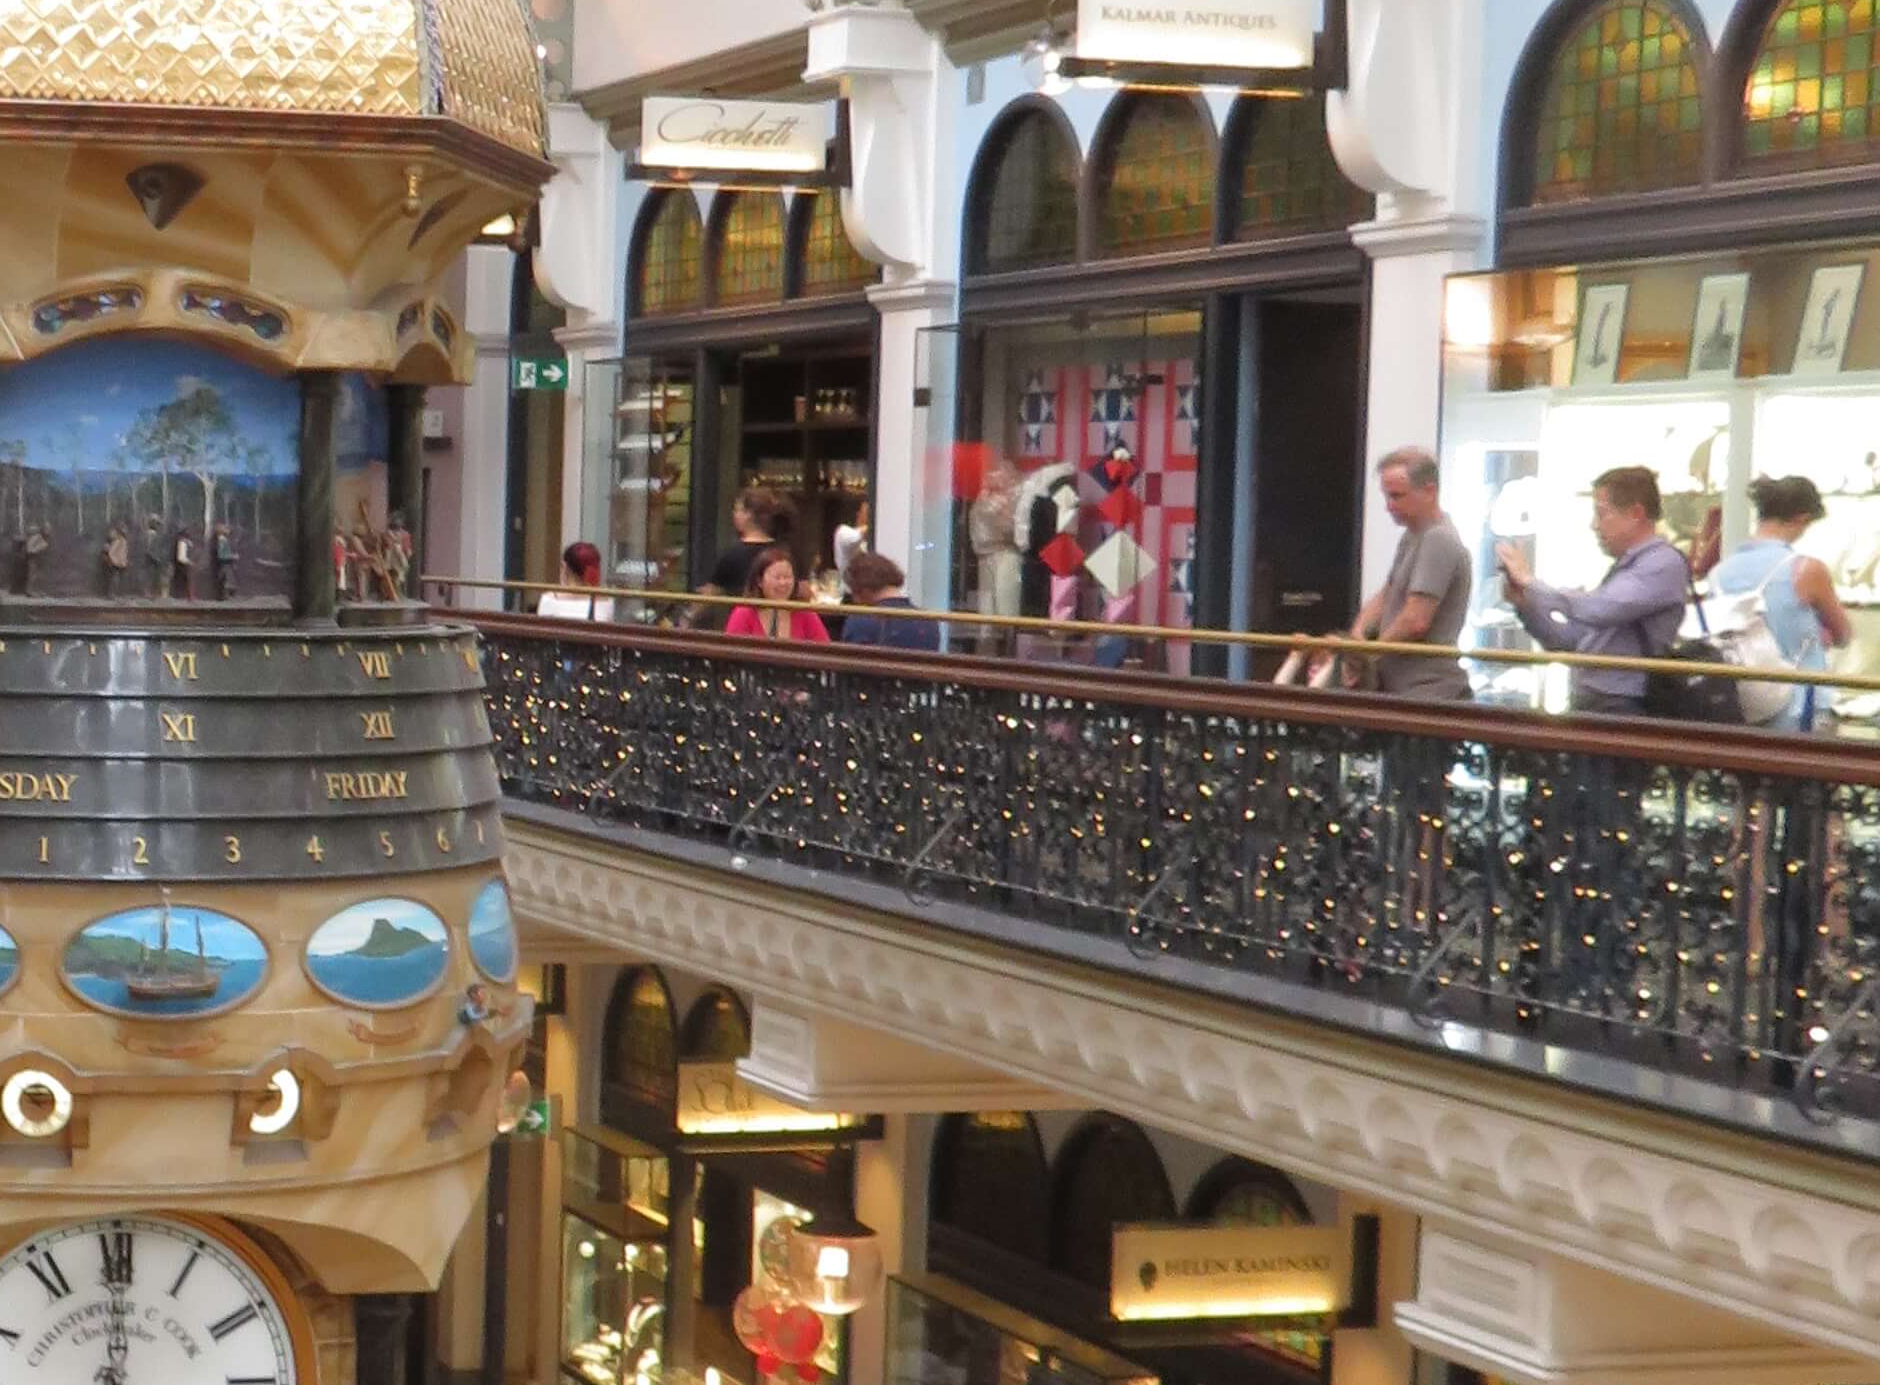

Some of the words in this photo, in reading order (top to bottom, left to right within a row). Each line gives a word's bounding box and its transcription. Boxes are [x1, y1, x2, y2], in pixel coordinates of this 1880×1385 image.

[1101, 5, 1177, 24] KALMAR
[1183, 9, 1278, 30] ANTIQUES
[164, 652, 198, 680] VI
[357, 651, 392, 679] VII
[161, 713, 198, 742] XI
[360, 710, 395, 739] XII
[325, 771, 409, 800] FRIDAY
[39, 835, 50, 864] 1
[132, 836, 150, 864] 2
[225, 836, 242, 864] 3
[305, 834, 324, 863] 4
[378, 830, 395, 857] 5
[435, 825, 451, 853] 6
[26, 1301, 136, 1368] CHRISTOPHR
[70, 1321, 158, 1348] Clockaker
